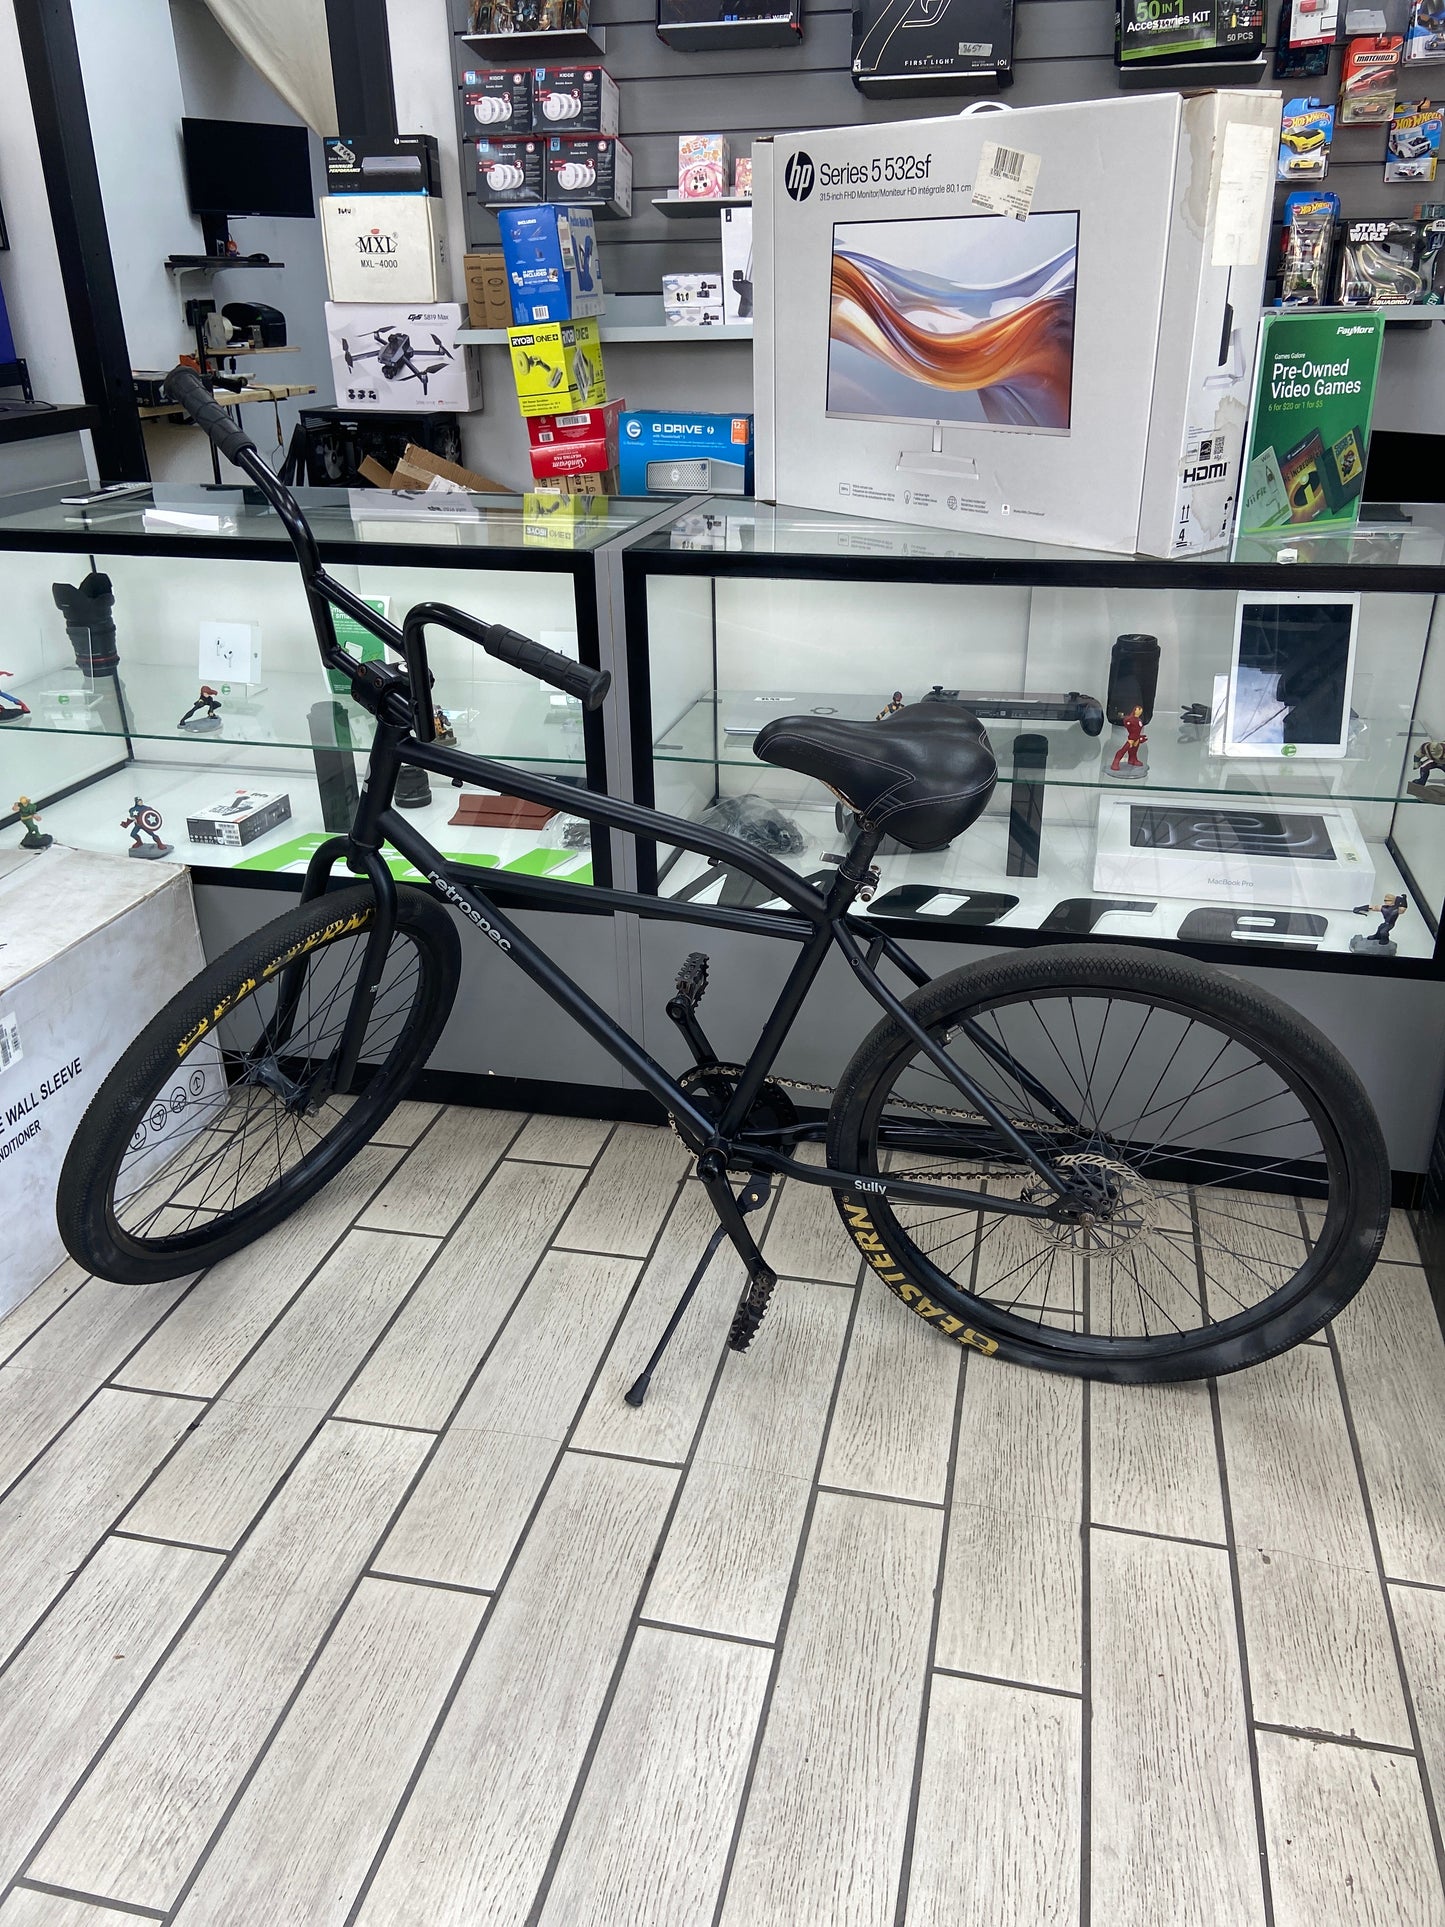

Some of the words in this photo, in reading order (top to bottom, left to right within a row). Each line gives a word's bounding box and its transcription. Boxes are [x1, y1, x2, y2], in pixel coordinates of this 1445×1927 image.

[1135, 0, 1161, 21] 50
[1162, 3, 1172, 13] IN
[1174, 0, 1184, 16] 1
[1193, 10, 1211, 23] KIT
[1227, 33, 1236, 42] 50
[1237, 32, 1254, 41] PCS
[786, 152, 814, 201] hp
[820, 162, 869, 186] Series
[871, 158, 882, 182] 5
[885, 153, 932, 181] 532sf
[843, 190, 857, 200] FHD
[907, 186, 917, 196] HD
[961, 183, 972, 192] cm
[1350, 223, 1389, 232] STAR
[358, 236, 396, 253] MXL
[1350, 231, 1389, 242] WARS
[360, 259, 398, 268] MXL-4000
[1336, 326, 1375, 337] PayMore
[512, 337, 534, 346] RYOBI
[1272, 358, 1350, 380] Pre-Owned
[1271, 380, 1310, 399] Video
[1314, 378, 1362, 396] Games
[1282, 402, 1294, 411] $20
[1315, 400, 1324, 408] $5
[1183, 461, 1229, 483] HDMI
[1178, 528, 1185, 541] 4
[1207, 877, 1241, 887] MacBook
[1242, 879, 1254, 887] Pro
[427, 870, 511, 951] retrospec
[5, 1092, 40, 1127] WALL
[40, 1057, 82, 1102] SLEEVE
[854, 1180, 887, 1195] Sully
[843, 1203, 965, 1335] EASTERN
